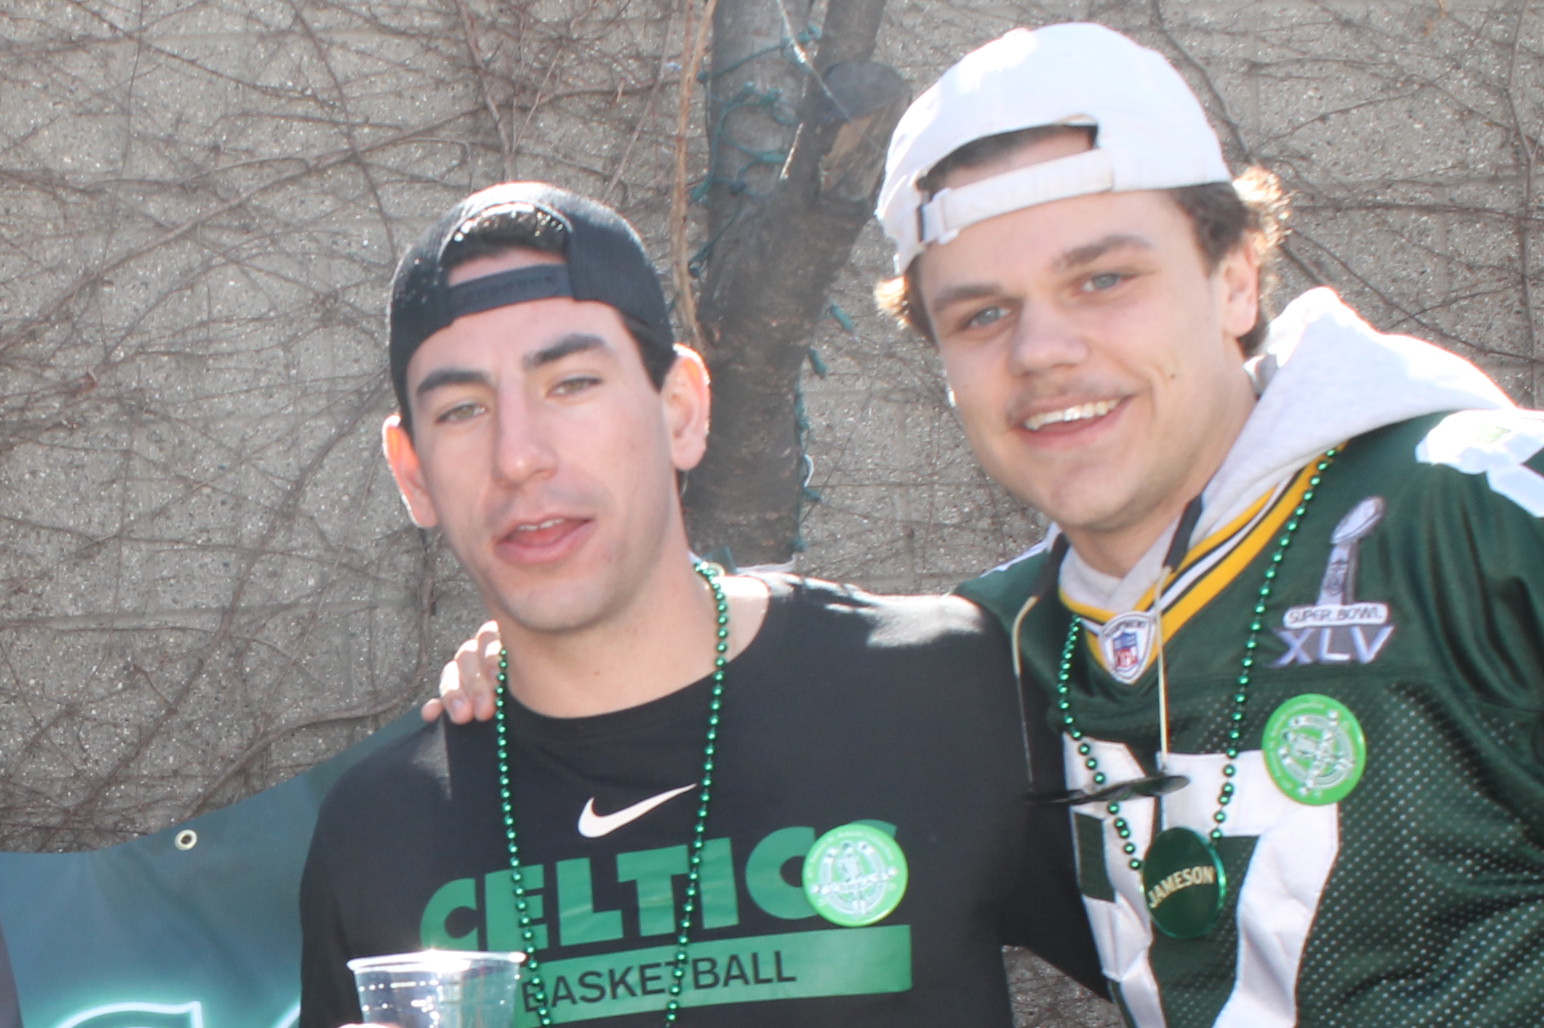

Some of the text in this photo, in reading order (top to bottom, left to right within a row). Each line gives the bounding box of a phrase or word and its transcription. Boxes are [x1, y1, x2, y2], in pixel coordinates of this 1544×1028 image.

[1289, 607, 1382, 623] SUPER BOWL
[1272, 625, 1395, 667] XLV
[420, 820, 897, 952] CELTIC
[1148, 866, 1216, 909] JAMESON
[521, 950, 797, 1012] BASKETBALL
